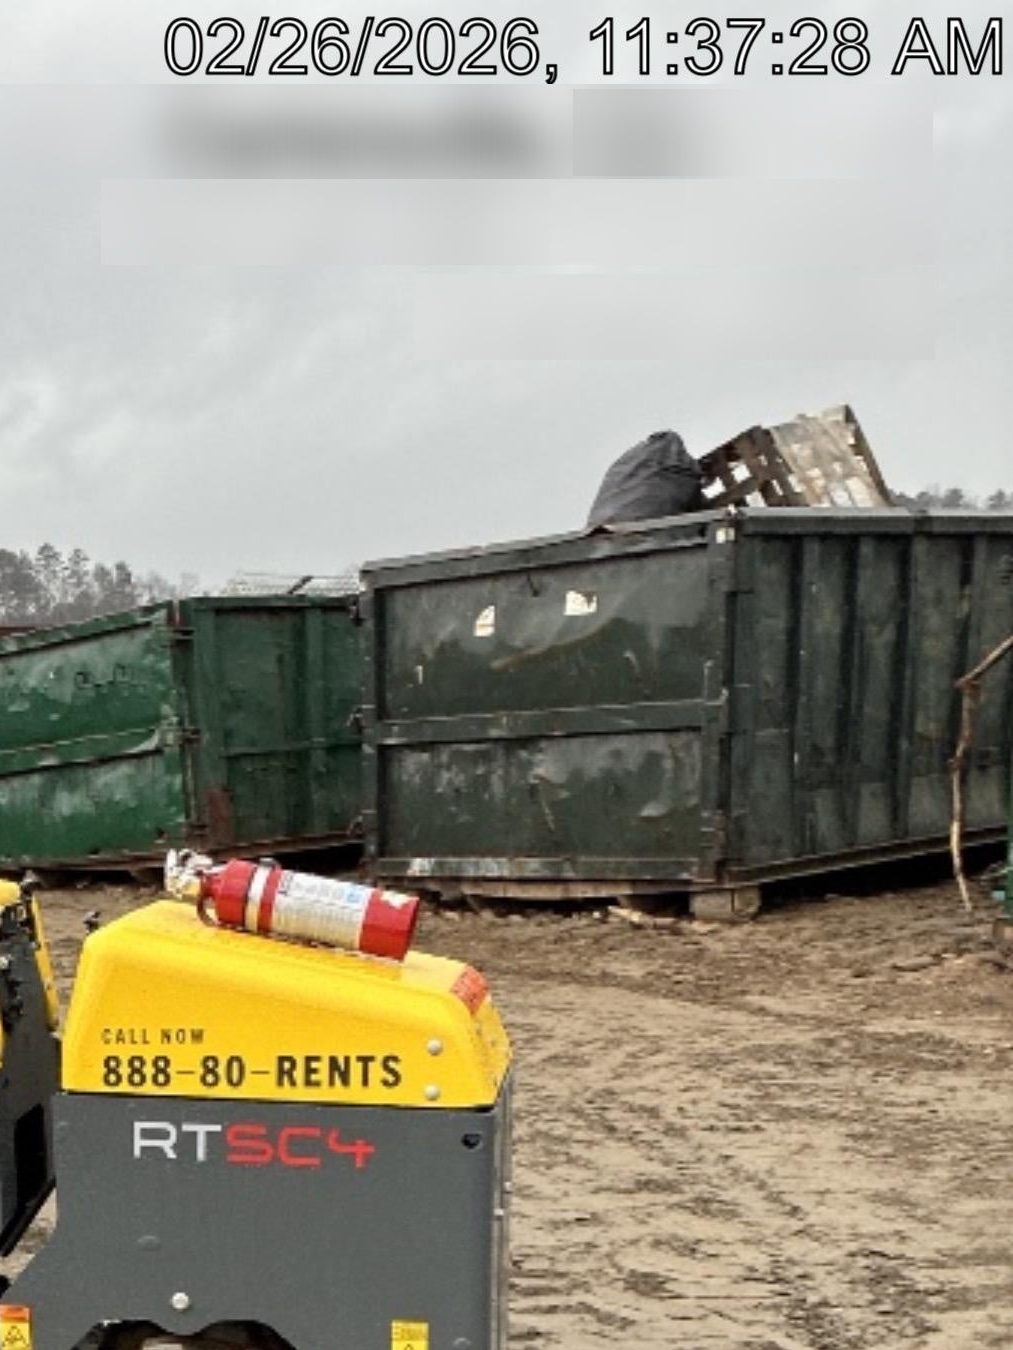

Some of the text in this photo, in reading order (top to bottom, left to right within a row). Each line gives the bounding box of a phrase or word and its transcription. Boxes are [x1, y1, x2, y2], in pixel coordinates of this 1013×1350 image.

[101, 1028, 205, 1045] CALL NOW
[103, 1055, 402, 1088] 888-80-RENTS
[132, 1121, 375, 1168] RTSC4
